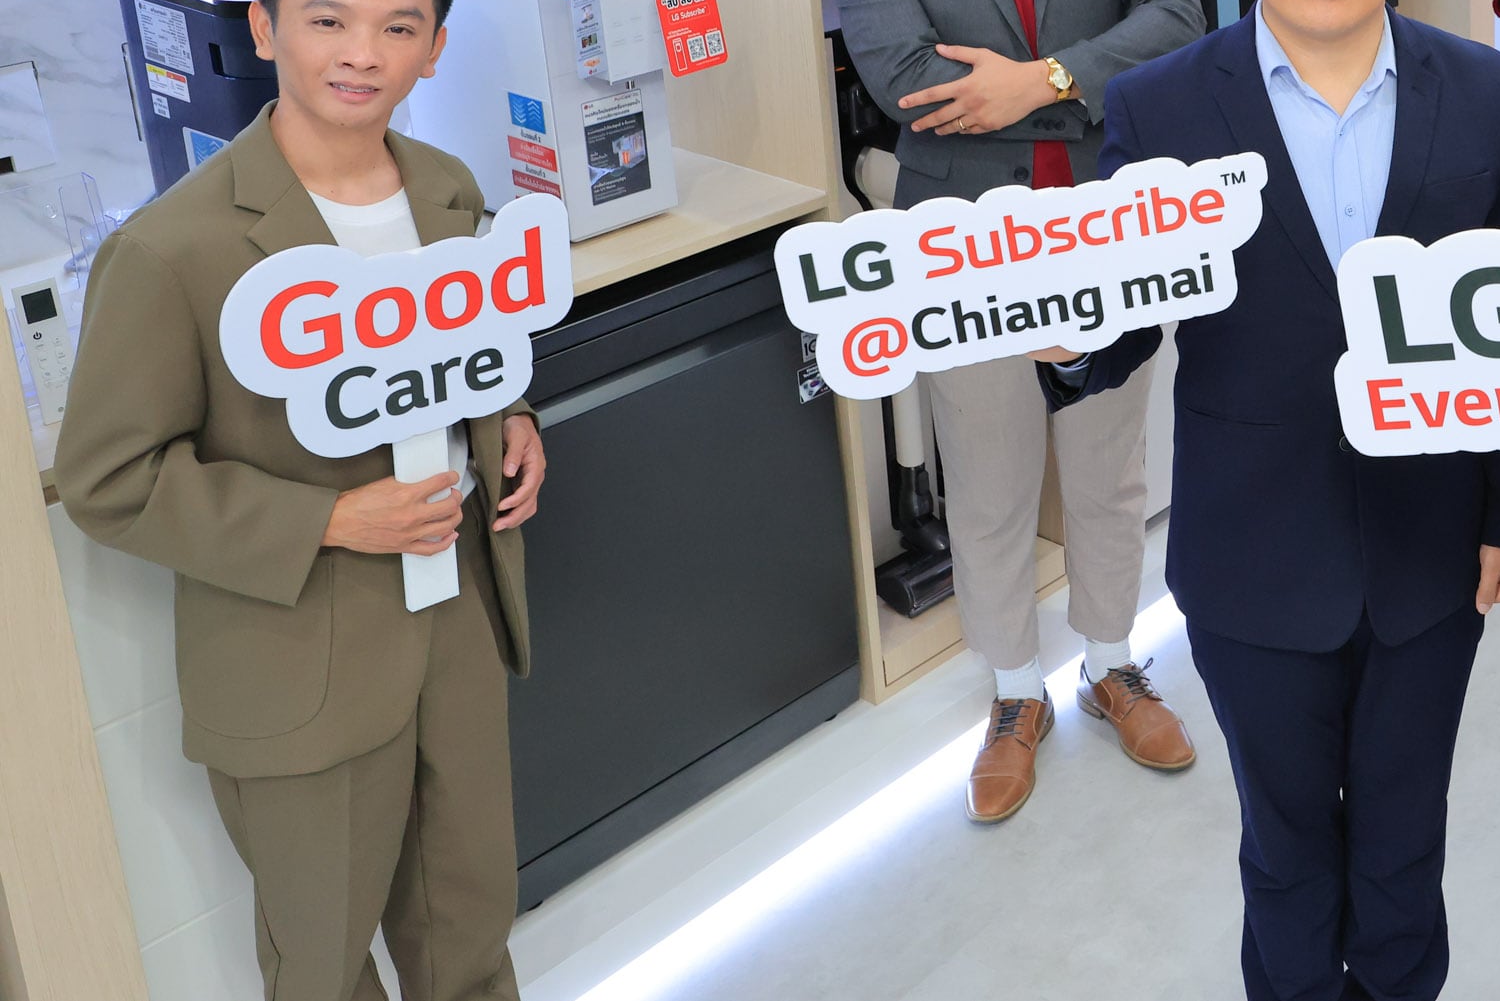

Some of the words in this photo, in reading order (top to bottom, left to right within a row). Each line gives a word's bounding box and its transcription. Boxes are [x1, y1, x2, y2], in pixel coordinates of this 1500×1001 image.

[671, 13, 679, 22] LG
[259, 226, 546, 370] Good
[799, 240, 894, 303] LG
[841, 285, 1105, 377] @Chiang
[1121, 252, 1215, 310] mai
[325, 348, 504, 430] Care
